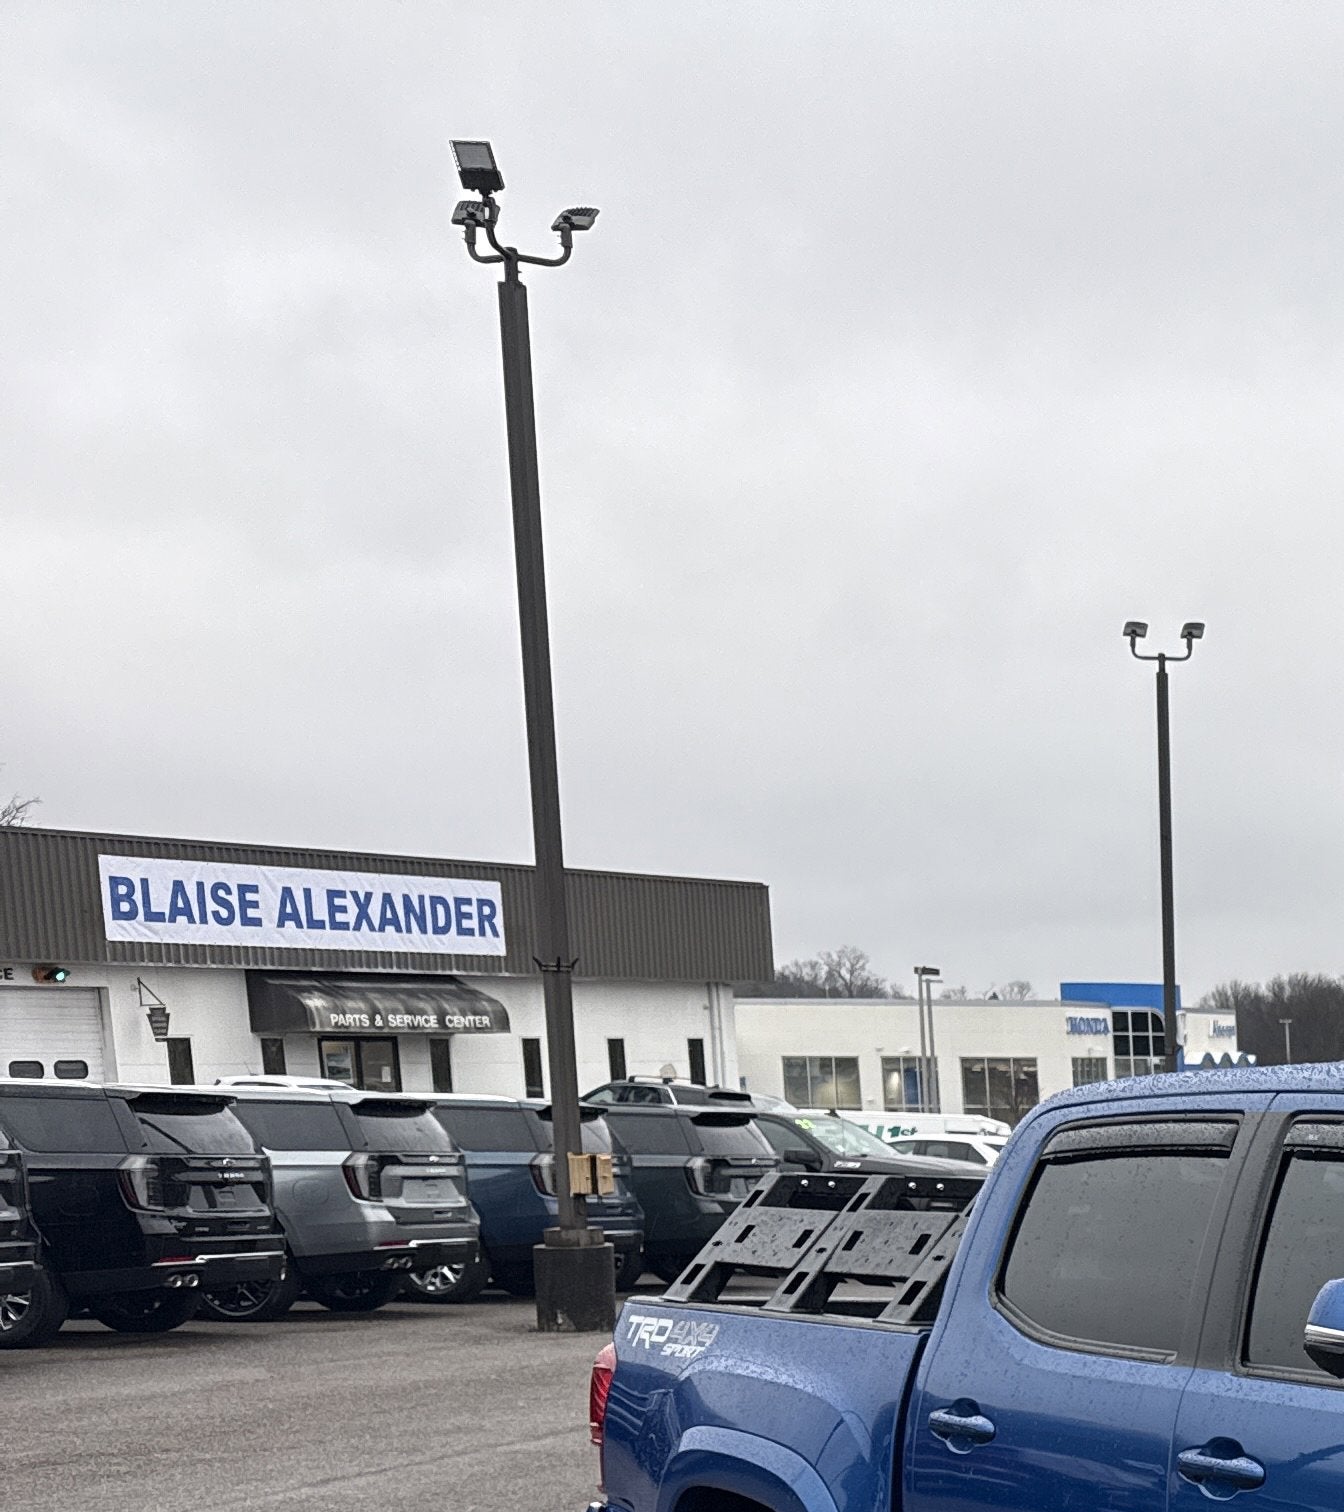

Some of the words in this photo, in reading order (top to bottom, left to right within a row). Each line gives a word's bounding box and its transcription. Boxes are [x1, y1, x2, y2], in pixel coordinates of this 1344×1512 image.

[108, 875, 263, 928] BLAISE
[276, 885, 501, 938] ALEXANDER
[330, 1013, 370, 1027] PARTS
[374, 1014, 384, 1027] &
[388, 1015, 439, 1028] SERVICE
[445, 1016, 491, 1028] CENTER
[626, 1314, 674, 1350] TRD
[660, 1342, 706, 1358] SPORT
